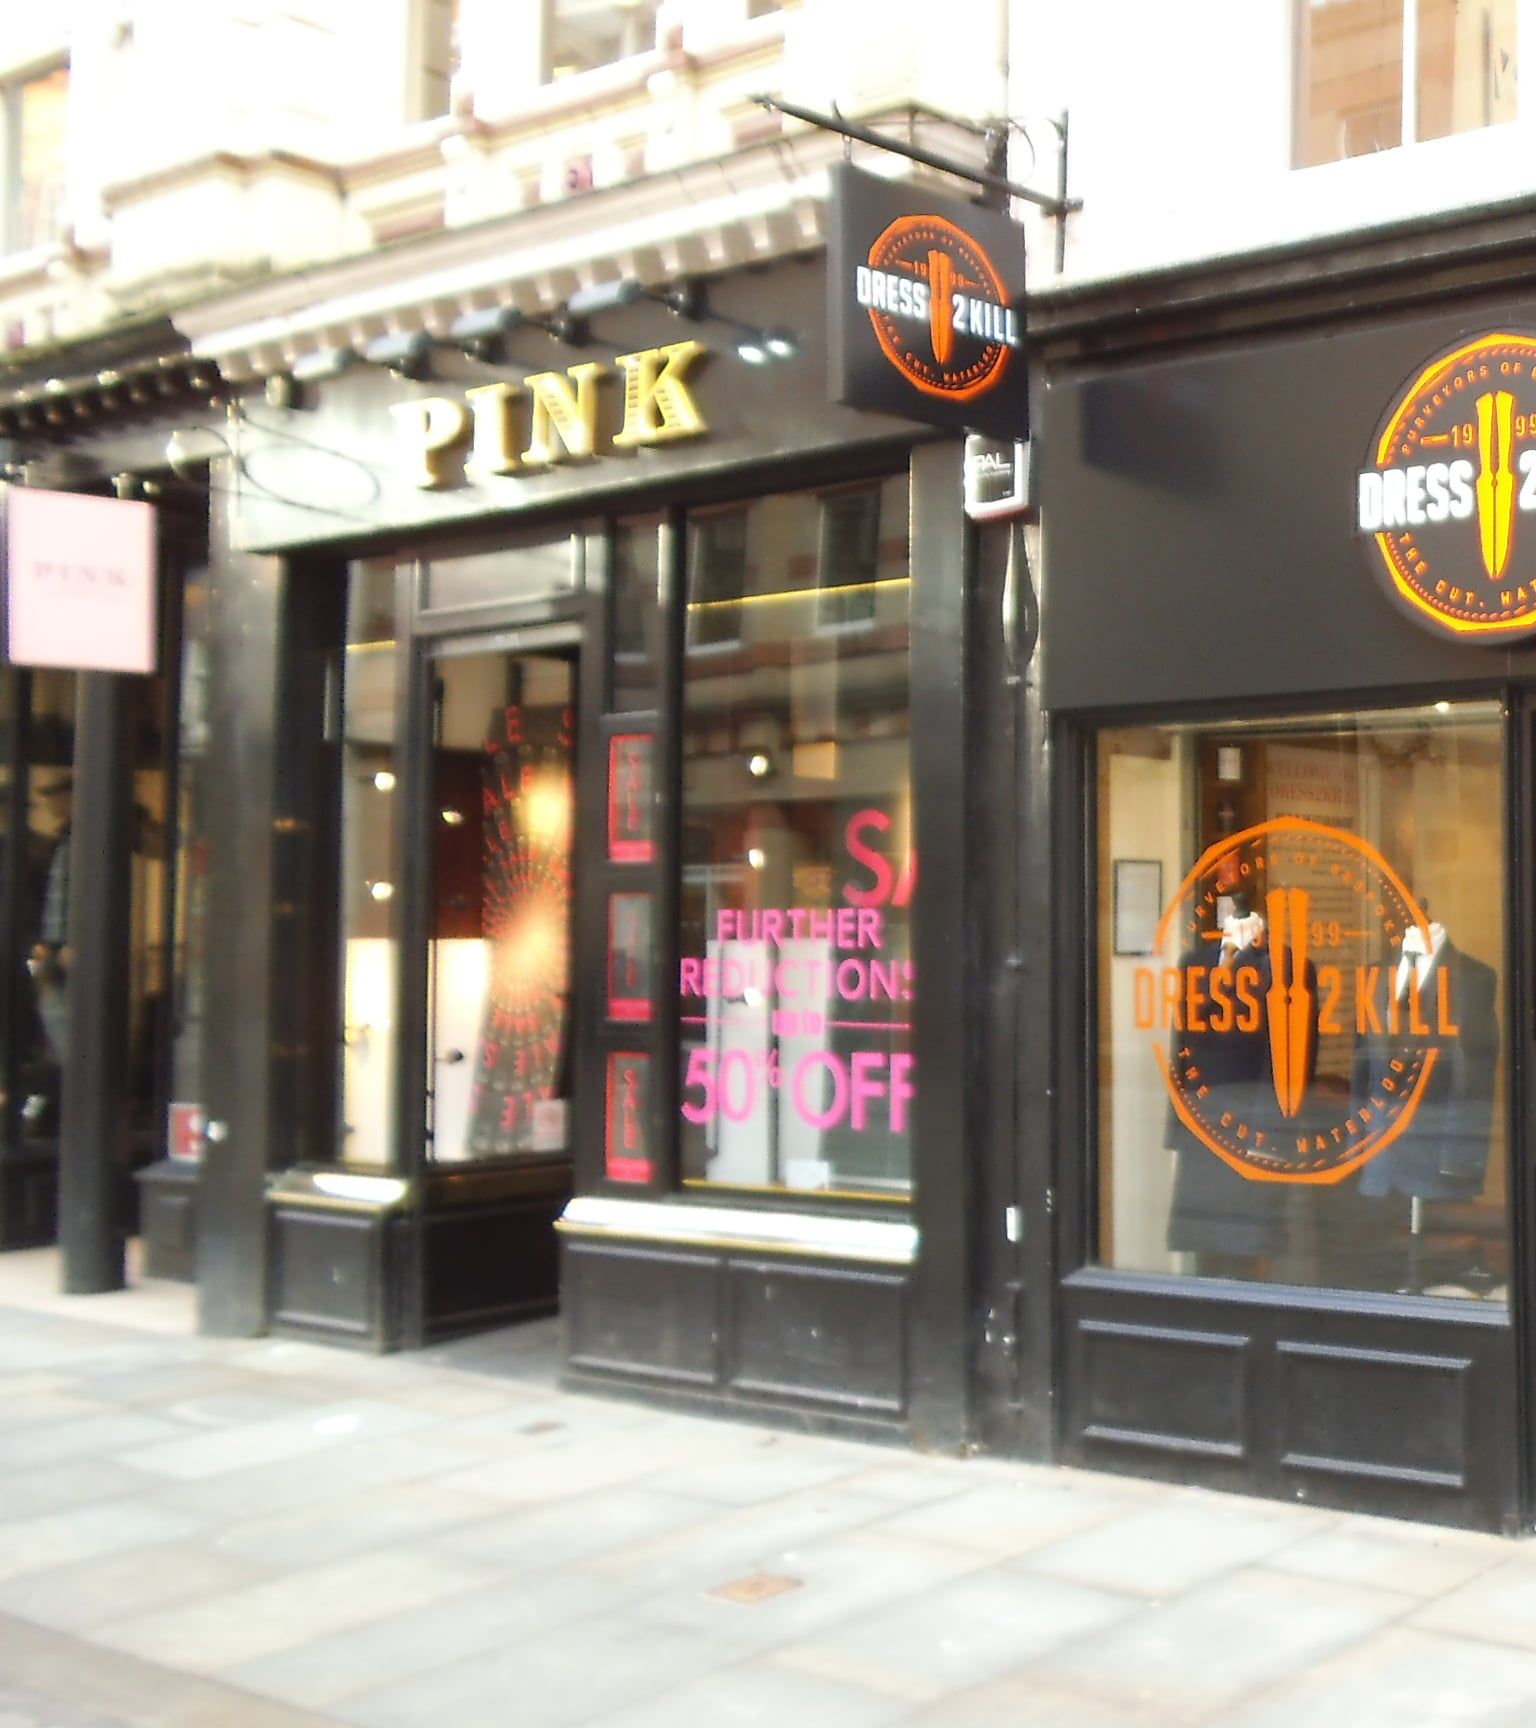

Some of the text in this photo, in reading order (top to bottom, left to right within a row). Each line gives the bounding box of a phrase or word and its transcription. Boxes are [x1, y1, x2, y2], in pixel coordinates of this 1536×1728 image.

[856, 264, 930, 321] DRESS
[970, 298, 1018, 346] KILL
[391, 339, 710, 491] PINK
[1401, 363, 1490, 455] PURVEYORS
[1499, 360, 1524, 376] OF
[1357, 459, 1475, 532] DRESS
[1399, 532, 1428, 576] THE
[716, 907, 883, 950] FURTHER
[1133, 964, 1460, 1037] DRESS 2 KILL
[681, 1047, 917, 1135] 50% OFF
[1178, 1046, 1211, 1099] THE
